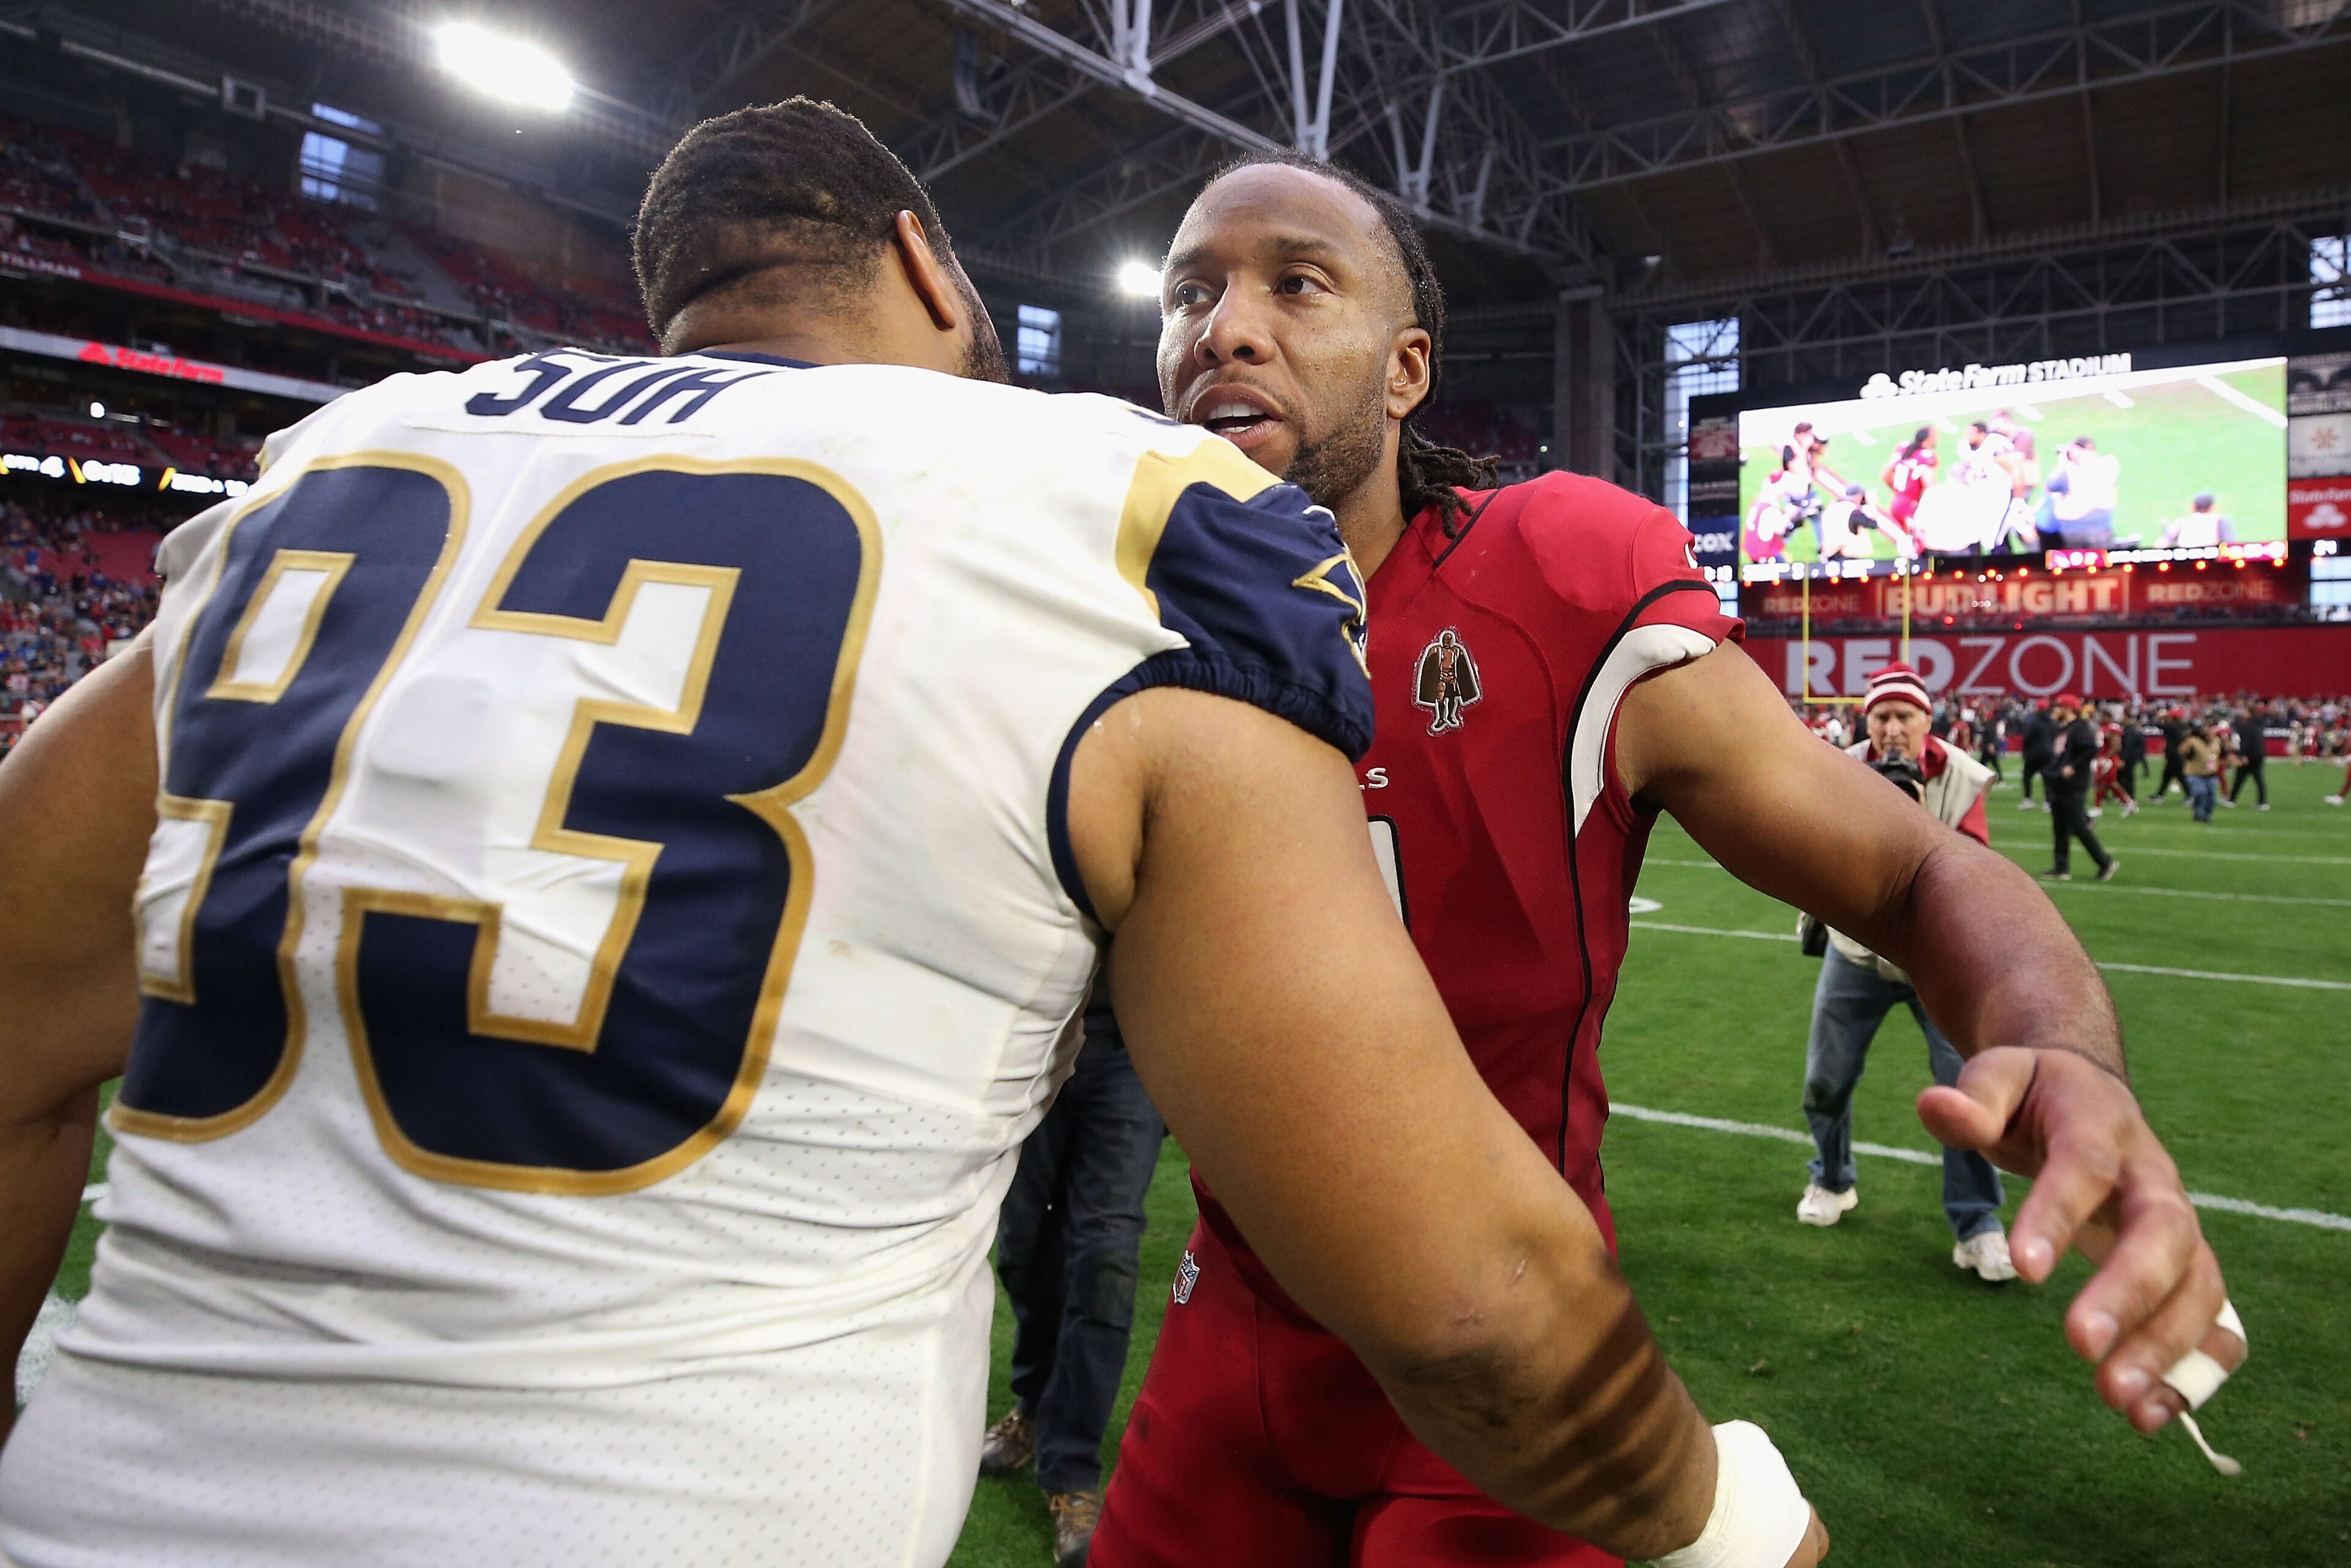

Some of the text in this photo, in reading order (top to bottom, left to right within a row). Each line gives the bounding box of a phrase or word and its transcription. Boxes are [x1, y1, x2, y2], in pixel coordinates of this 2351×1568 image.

[465, 347, 786, 425] SUH
[2027, 352, 2132, 382] STADIUM
[1886, 577, 2119, 616] BUD LIGHT
[109, 450, 883, 1196] 93
